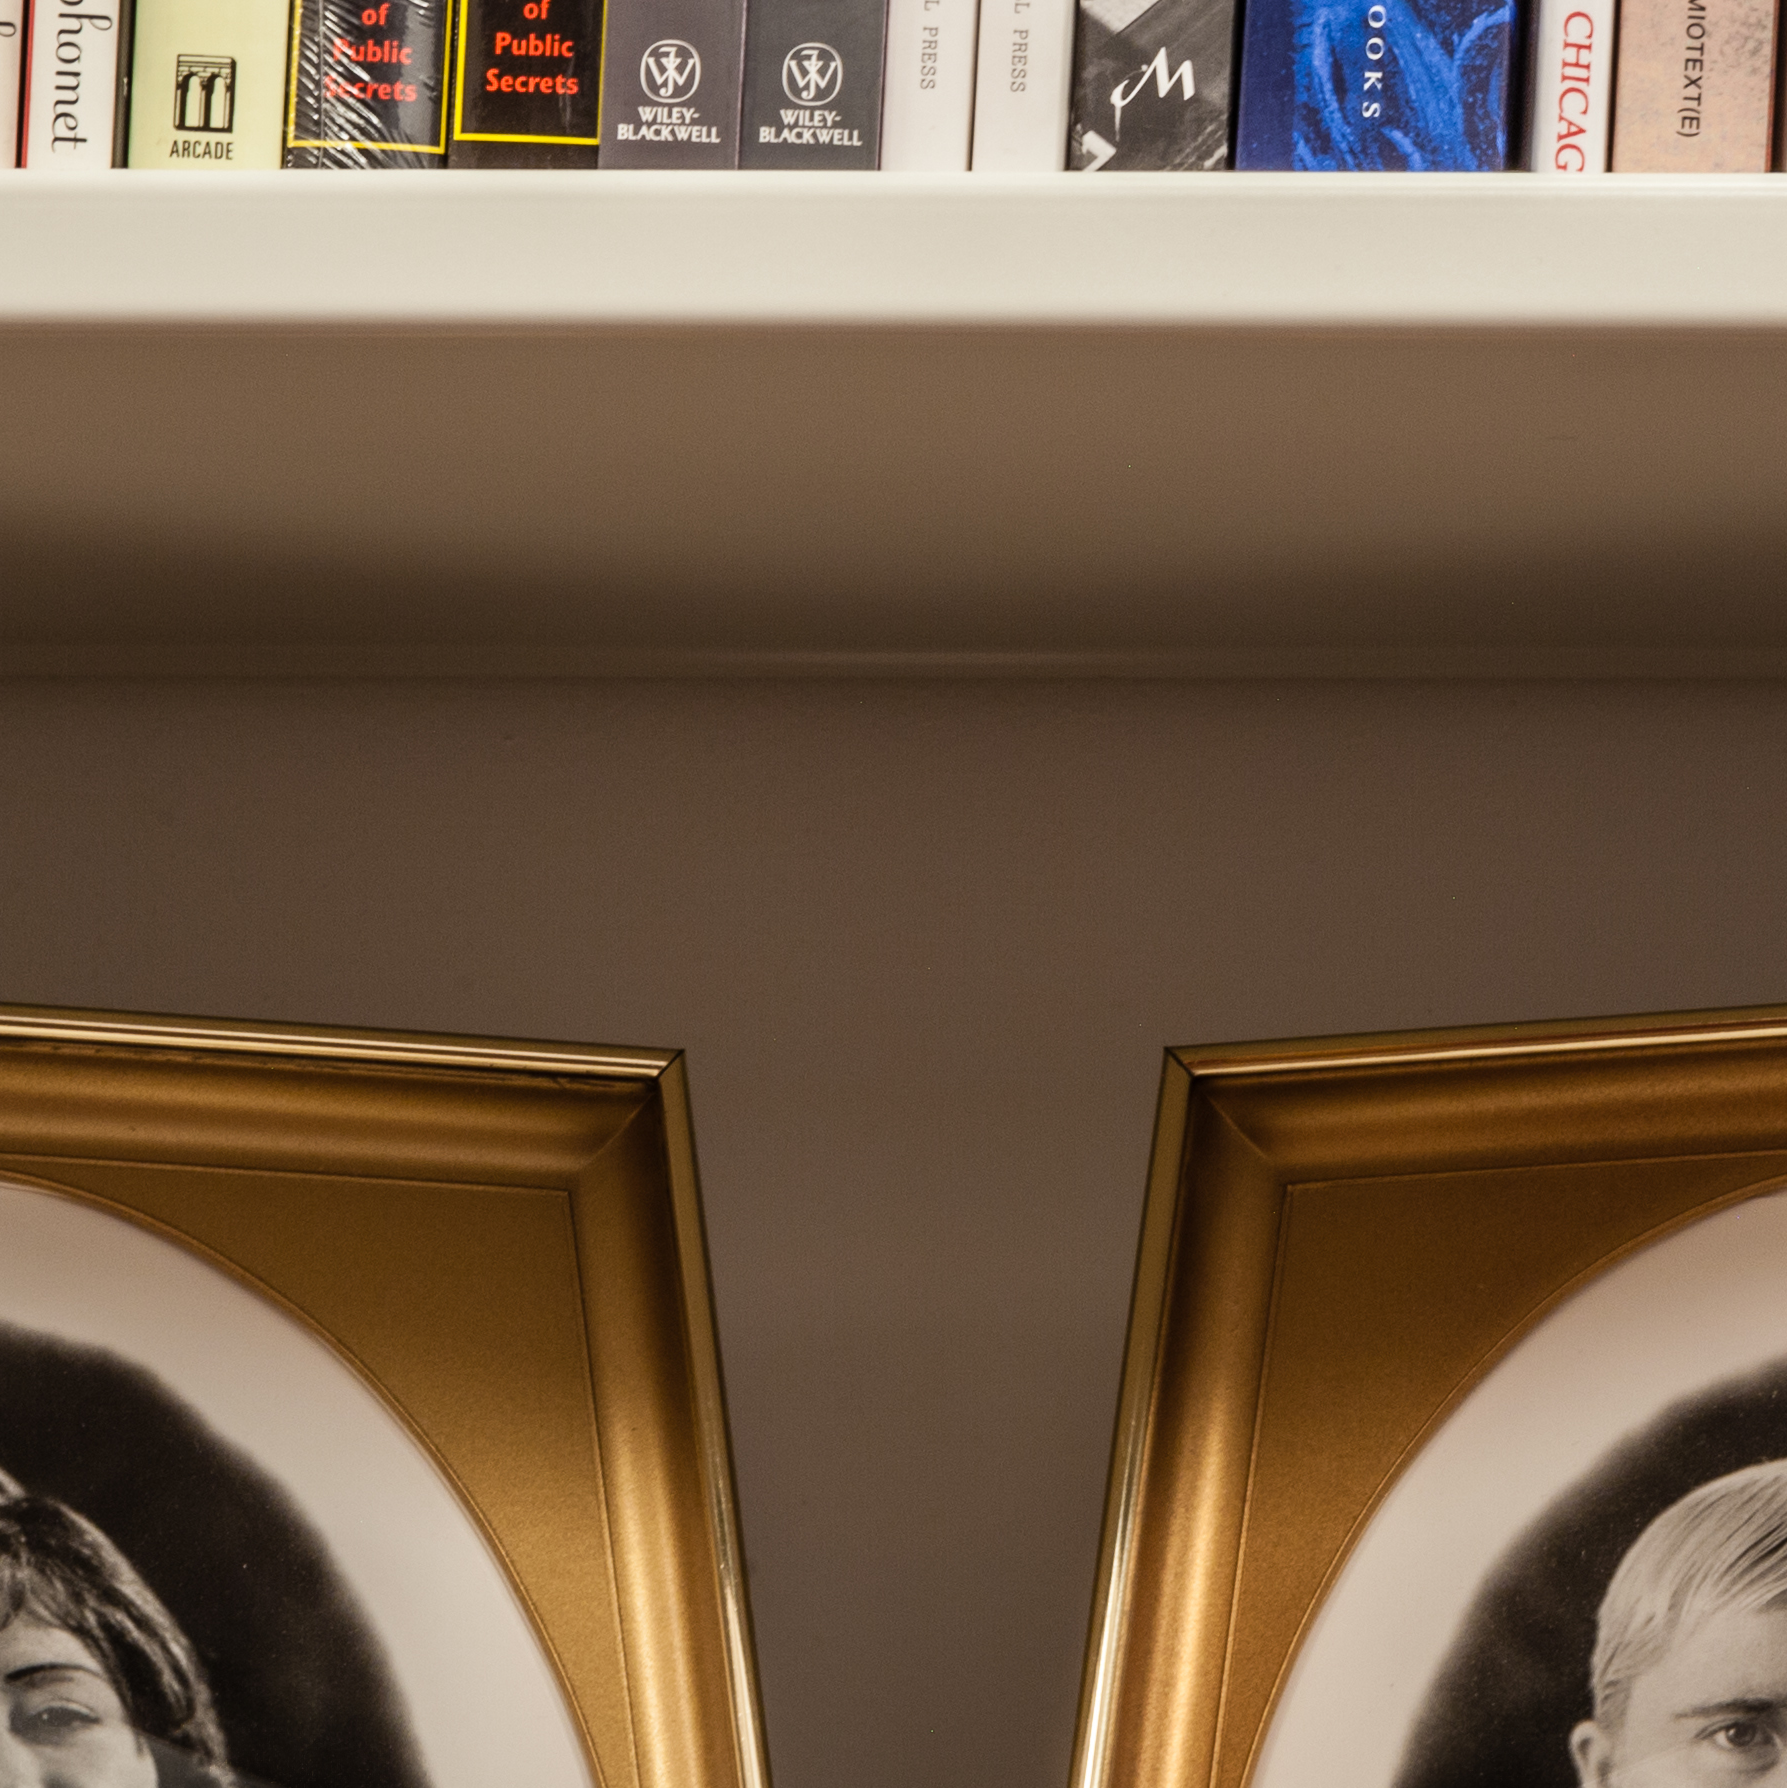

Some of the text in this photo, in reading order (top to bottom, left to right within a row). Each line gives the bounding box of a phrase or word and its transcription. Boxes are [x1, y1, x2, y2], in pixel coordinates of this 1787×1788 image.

[361, 3, 391, 26] of
[523, 0, 551, 20] of
[332, 38, 413, 65] Public
[494, 32, 575, 59] Public
[919, 26, 939, 90] PRESS
[1009, 29, 1029, 93] PRESS
[1361, 4, 1388, 119] OOKS
[51, 0, 113, 153] homet
[324, 75, 417, 102] Secrets
[486, 69, 579, 96] Secrets
[1554, 11, 1594, 173] CHICAG
[638, 106, 701, 124] WILEY-
[779, 109, 842, 127] WILEY-
[617, 122, 721, 144] BLACKWELL
[758, 126, 863, 147] BLACKWELL
[169, 139, 234, 162] ARCADE
